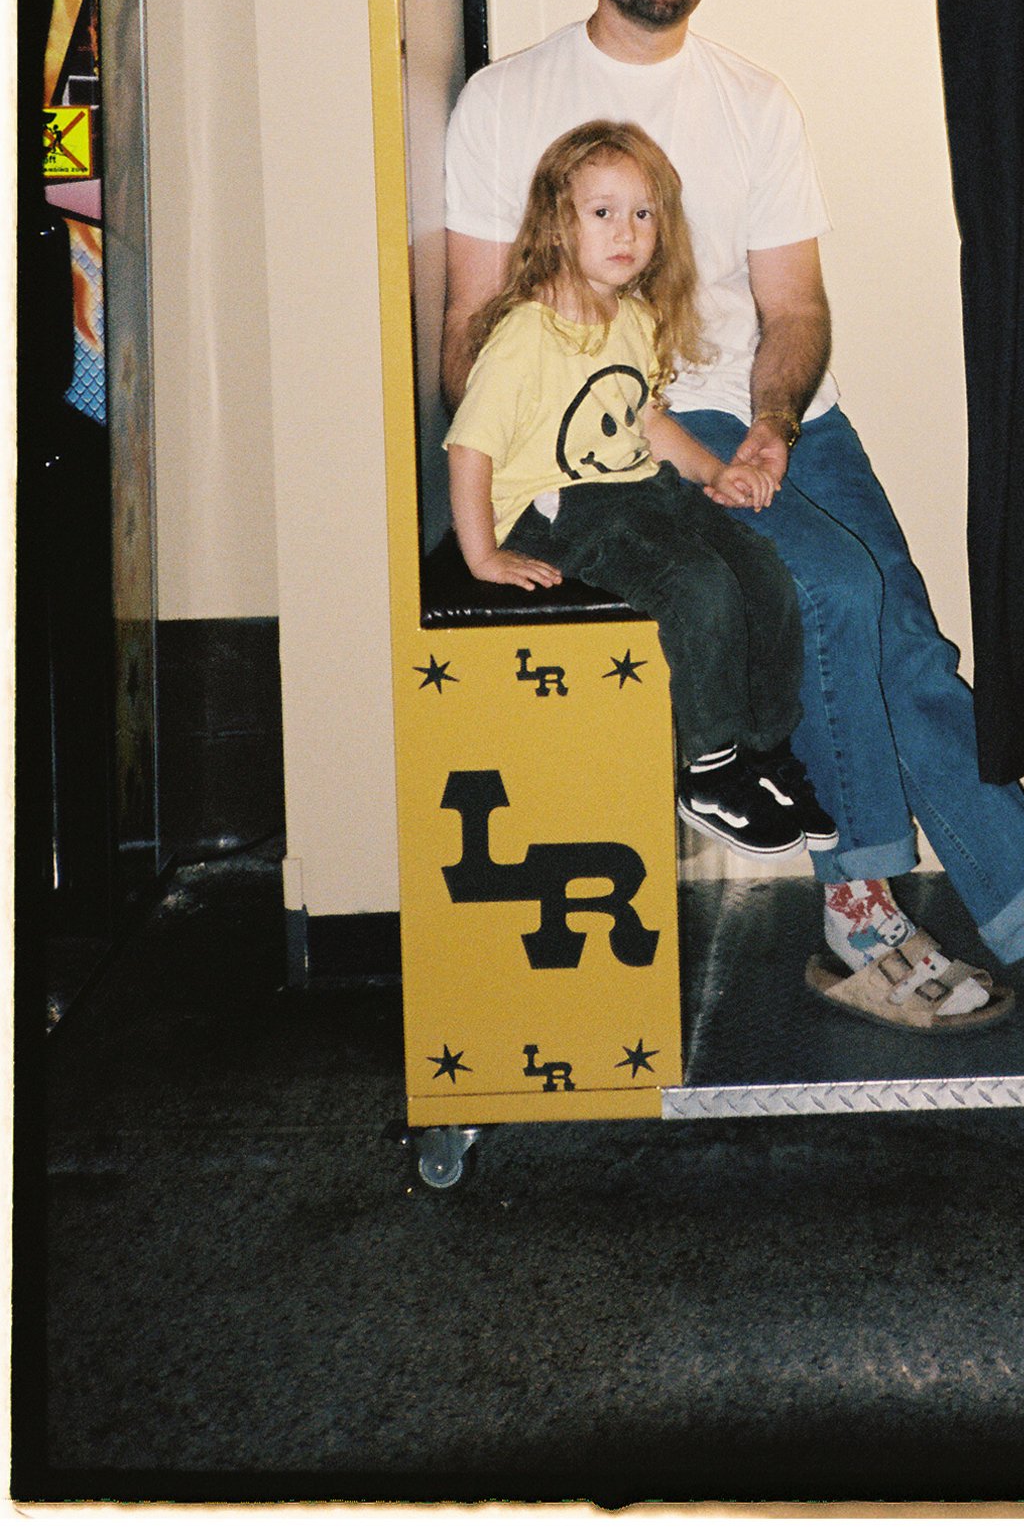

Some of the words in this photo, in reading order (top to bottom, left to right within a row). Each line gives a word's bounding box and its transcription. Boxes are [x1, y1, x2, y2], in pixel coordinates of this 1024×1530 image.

[515, 648, 568, 697] LR
[439, 769, 660, 969] LR
[522, 1044, 575, 1091] LR
